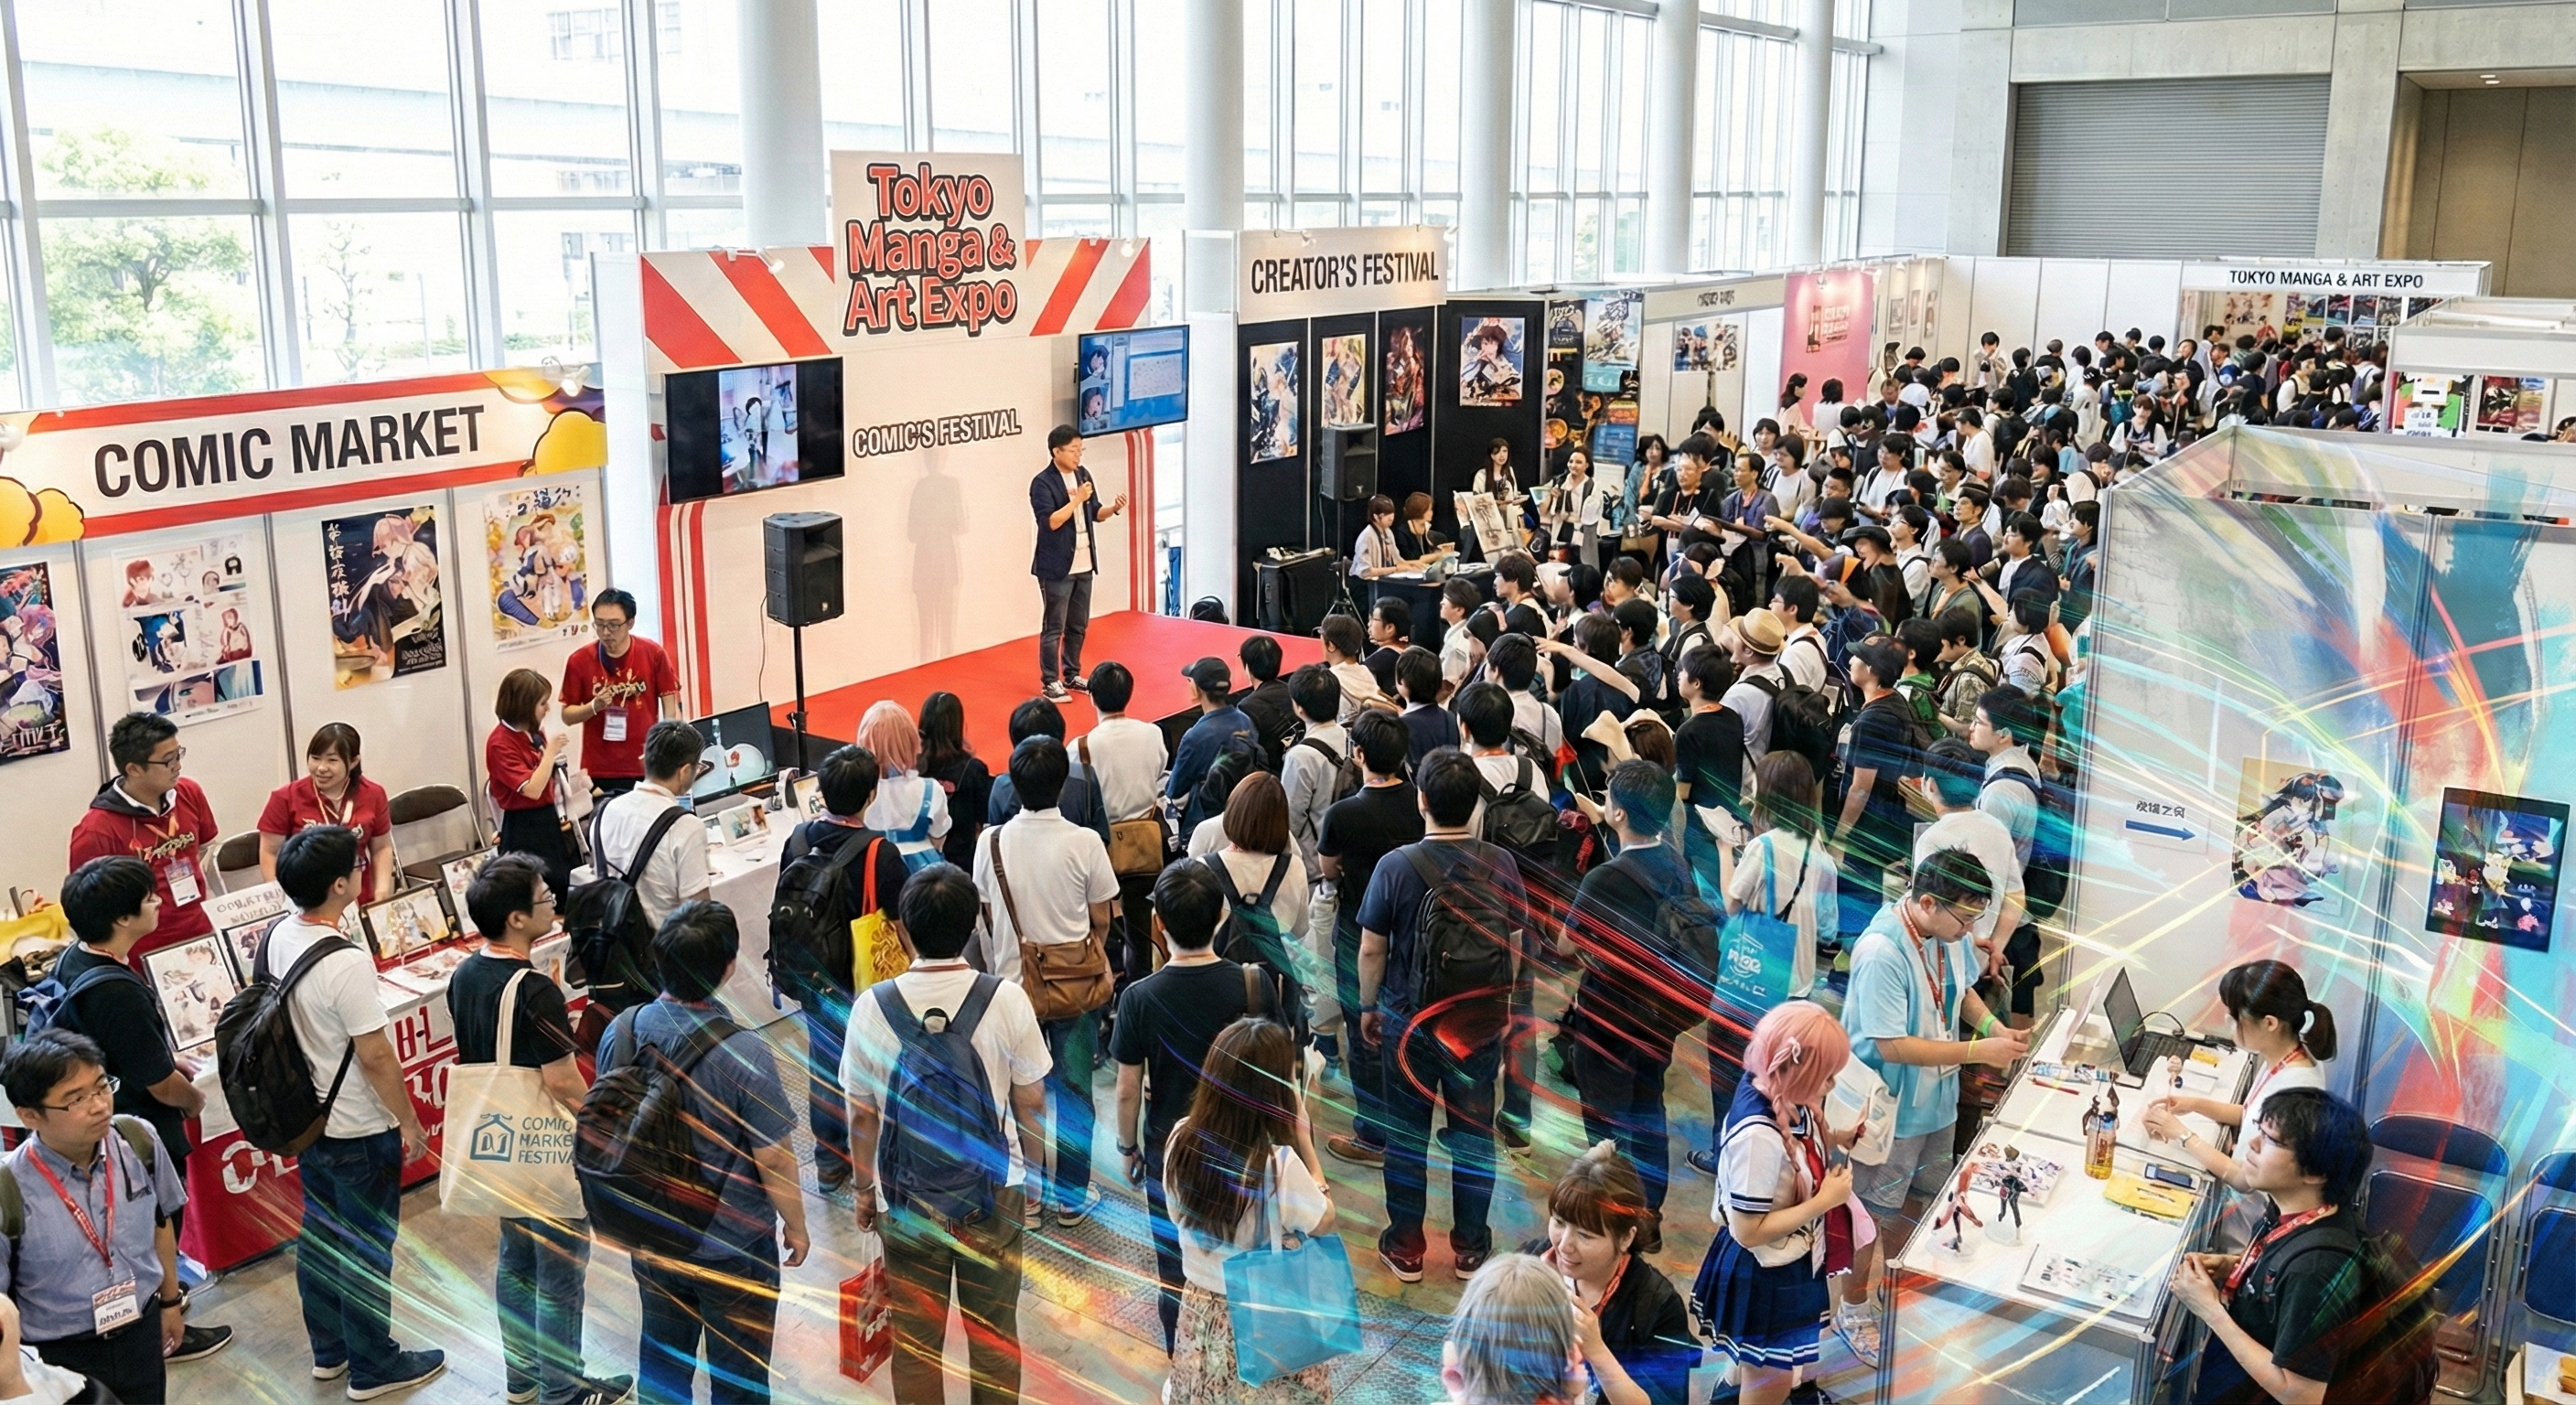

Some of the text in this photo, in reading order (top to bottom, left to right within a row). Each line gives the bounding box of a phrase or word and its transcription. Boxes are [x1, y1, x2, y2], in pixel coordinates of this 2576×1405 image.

[867, 162, 993, 229] Tokyo
[846, 220, 1016, 283] Manga &
[1251, 252, 1439, 295] CREATOR'S FESTIVAL
[2229, 271, 2424, 288] TOKYO MANGA & ART EXPO
[843, 275, 1017, 338] Art Expo
[94, 405, 485, 499] COMIC MARKET
[853, 408, 1022, 458] COMIC'S FESTIVAL
[520, 1133, 574, 1148] MARKE
